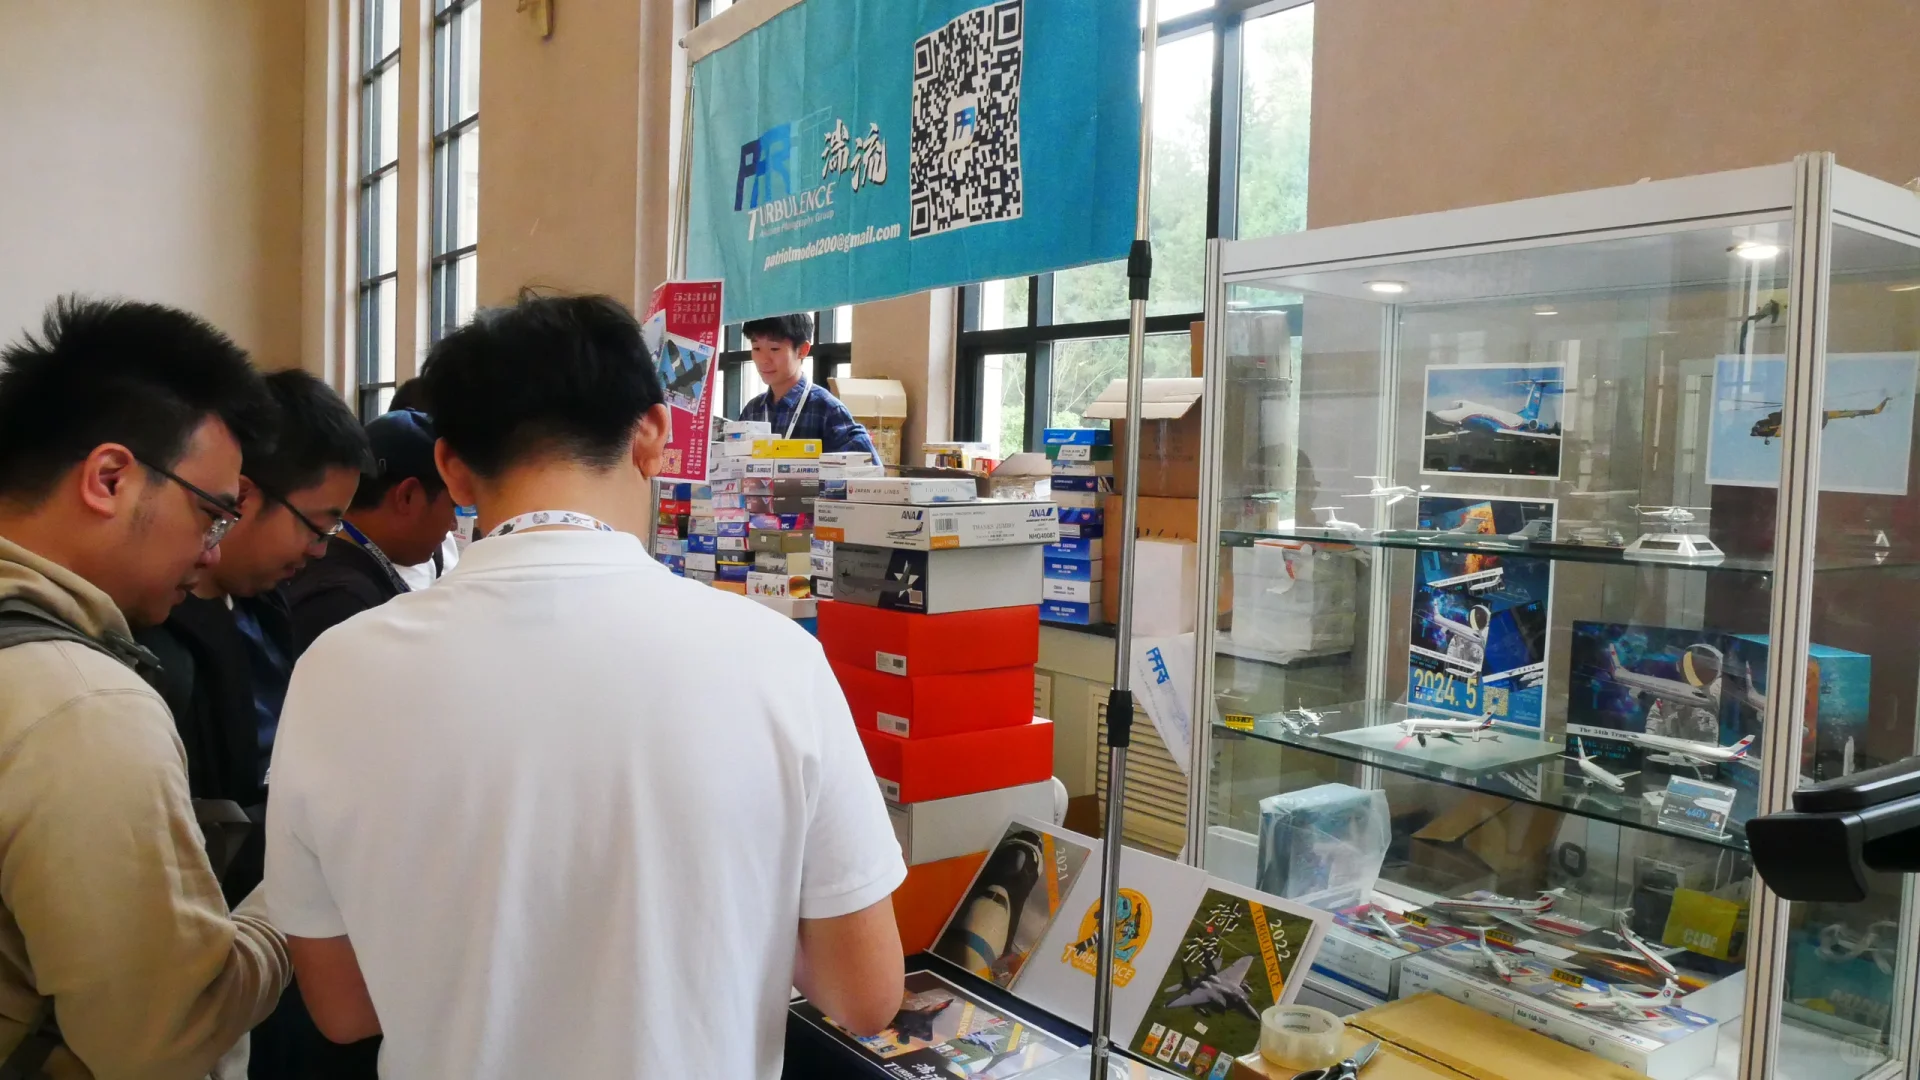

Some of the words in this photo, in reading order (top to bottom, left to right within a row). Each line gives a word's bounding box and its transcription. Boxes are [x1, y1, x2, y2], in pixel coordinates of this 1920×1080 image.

[748, 181, 837, 241] TURBULENCE
[763, 223, 901, 272] patriotmodel200@gmail.com
[901, 510, 916, 520] ANA
[1028, 508, 1046, 518] ANA
[1055, 847, 1069, 881] 2021
[1253, 906, 1283, 990] TURBULENCE
[1268, 918, 1291, 963] 2022
